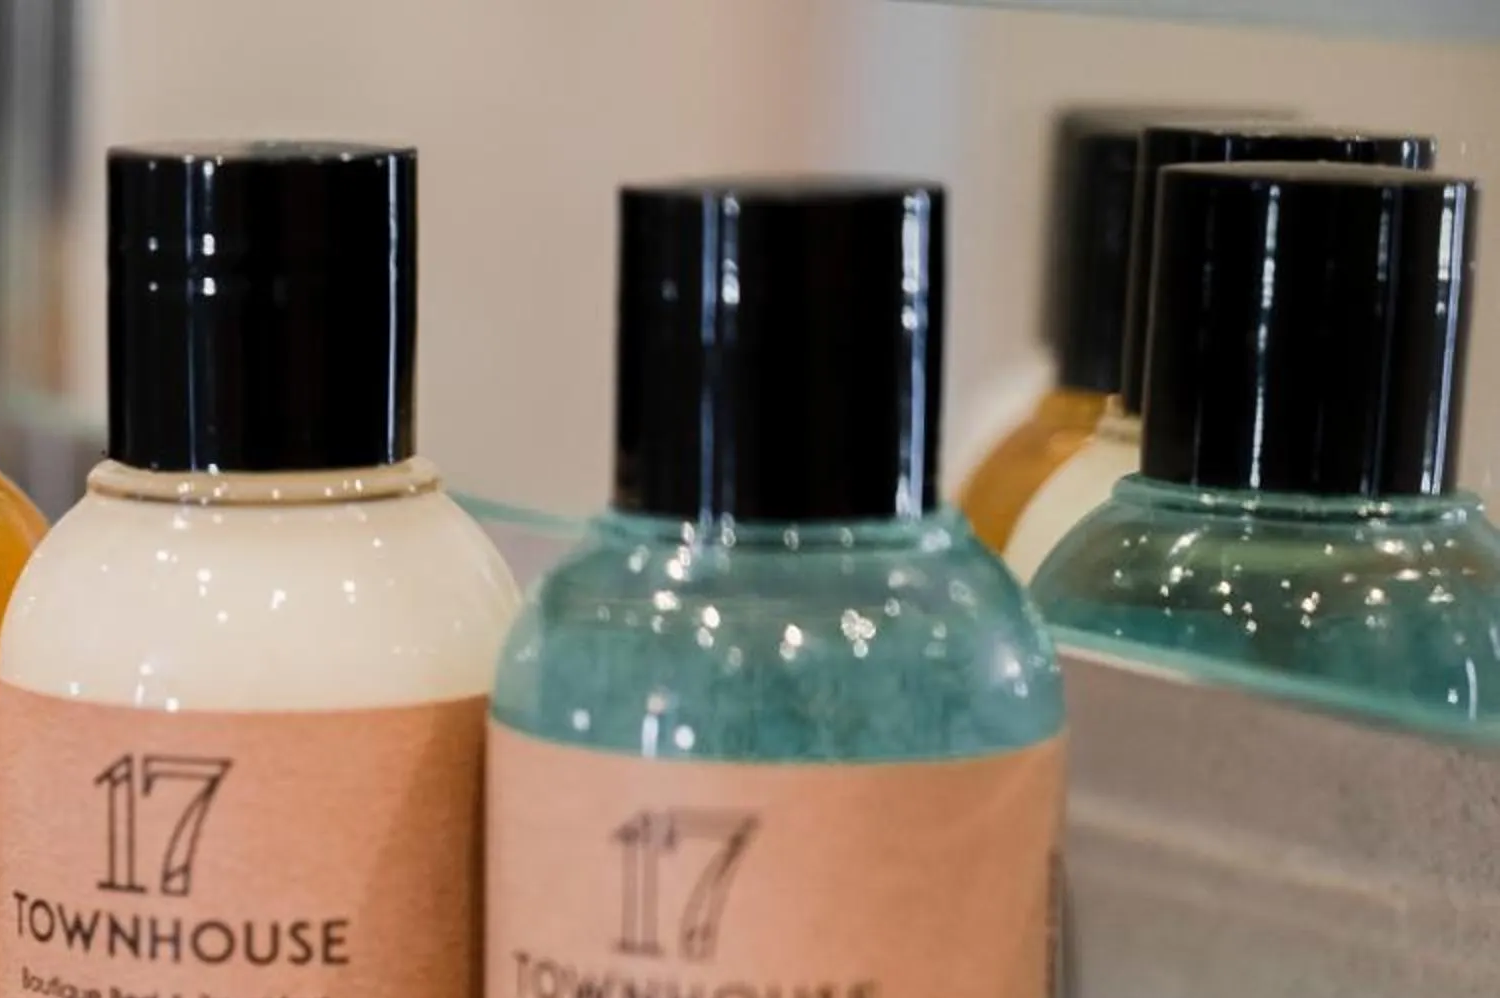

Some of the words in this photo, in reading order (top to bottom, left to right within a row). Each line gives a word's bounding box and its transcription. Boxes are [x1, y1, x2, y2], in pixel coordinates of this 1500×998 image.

[93, 752, 234, 898] 17
[611, 810, 761, 962] 17
[12, 890, 351, 966] TOWNHOUSE
